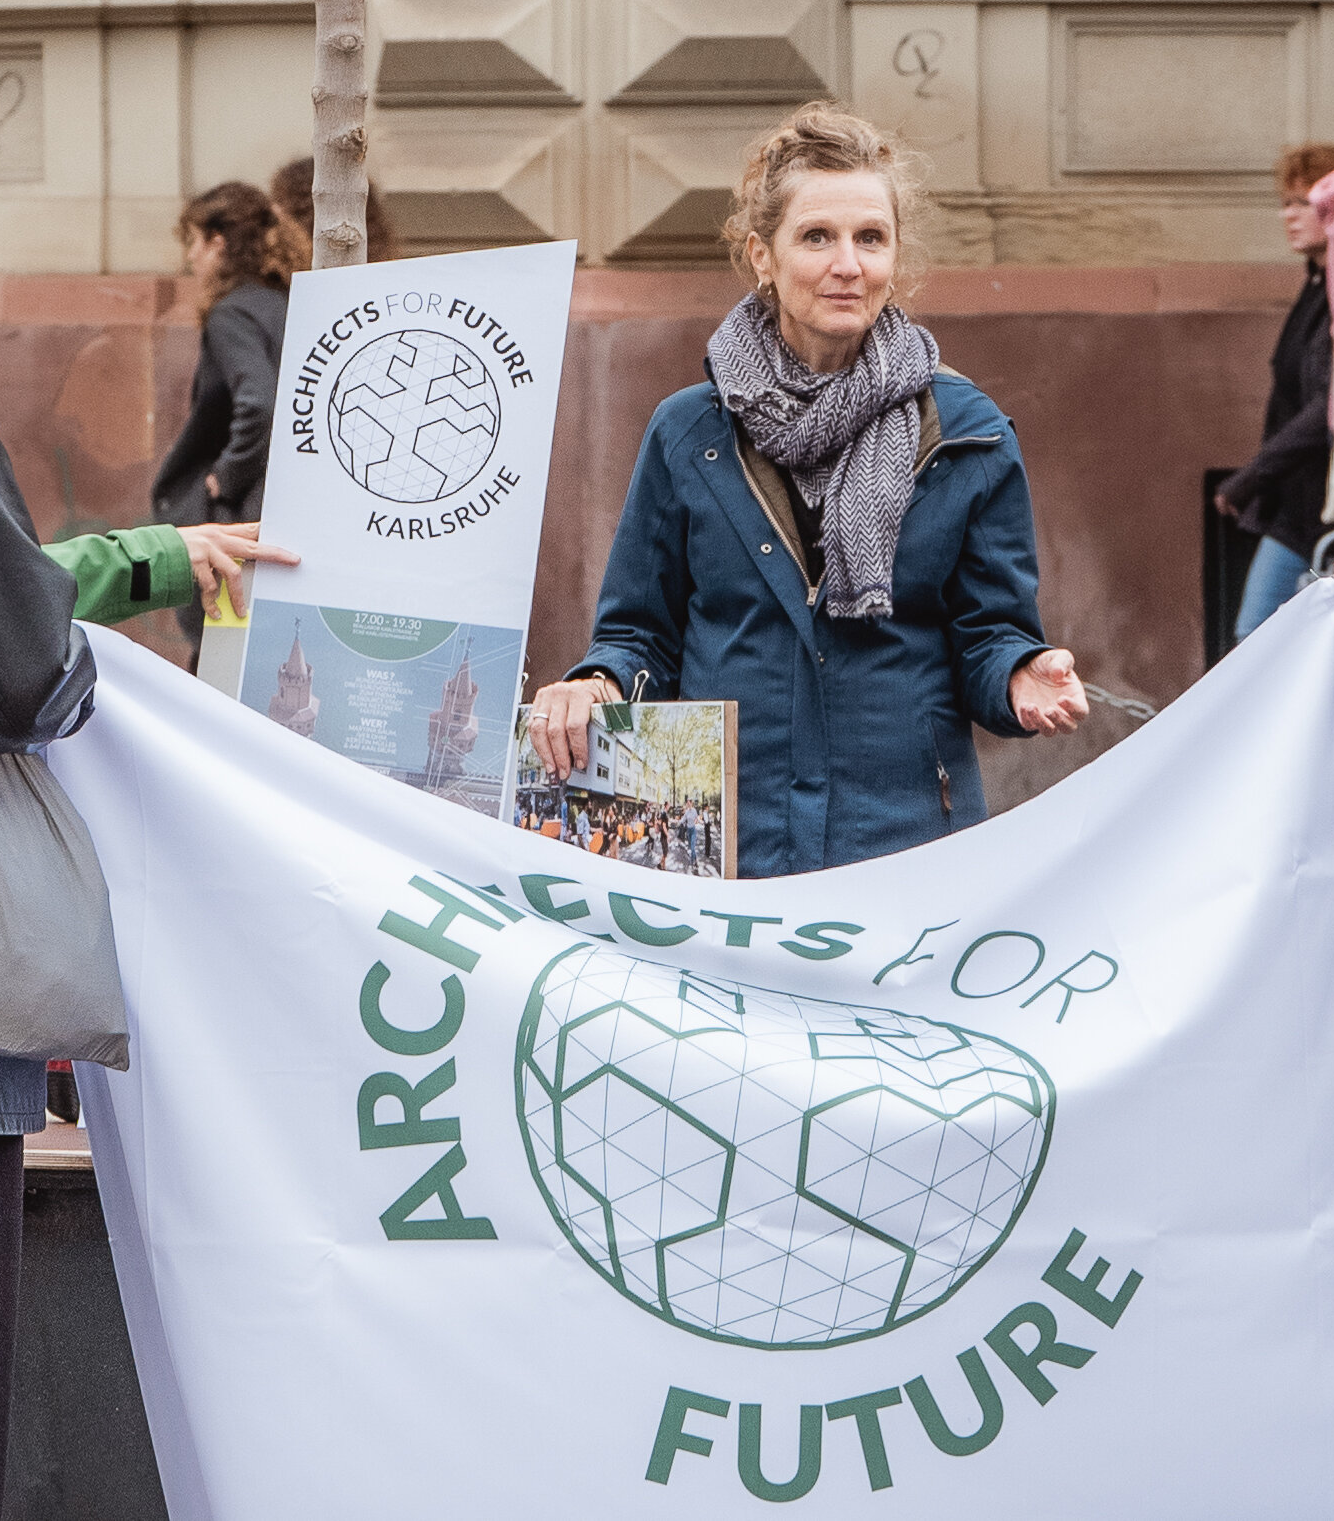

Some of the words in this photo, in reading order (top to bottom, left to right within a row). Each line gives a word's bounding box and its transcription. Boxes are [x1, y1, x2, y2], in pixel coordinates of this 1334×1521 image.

[292, 301, 380, 455] ARCHITECTS
[385, 291, 442, 316] FOR
[447, 298, 534, 388] FUTURE
[366, 465, 521, 540] KARLSRUHE
[354, 612, 385, 626] 17.00
[392, 616, 423, 630] 19.30
[360, 717, 388, 729] WER?
[872, 918, 1119, 1025] FOR
[357, 869, 866, 1241] ARCHECTS
[645, 1227, 1145, 1503] FUTURE
